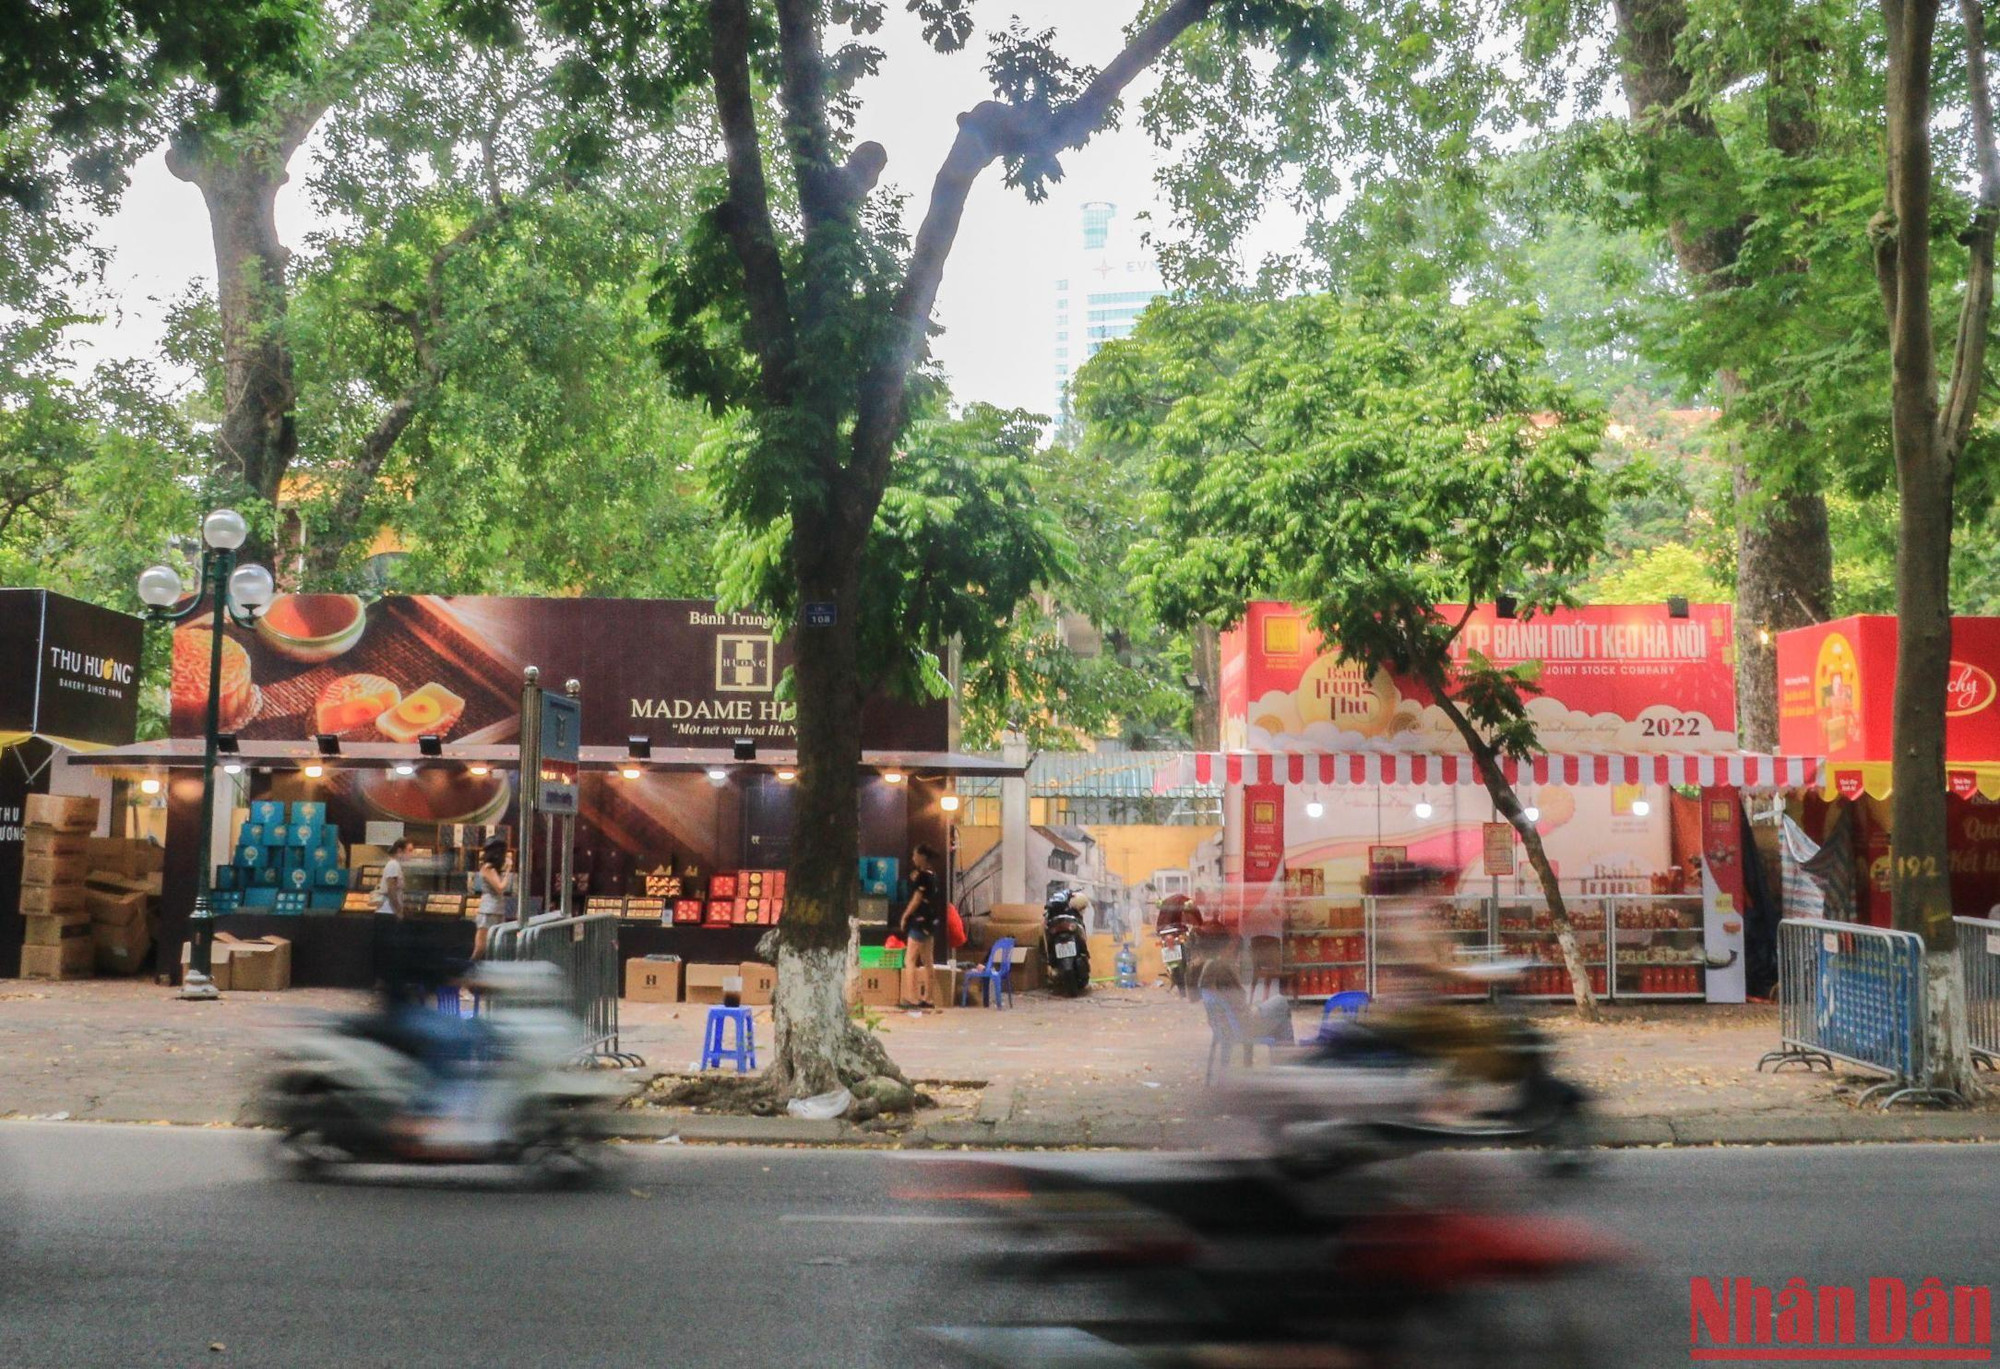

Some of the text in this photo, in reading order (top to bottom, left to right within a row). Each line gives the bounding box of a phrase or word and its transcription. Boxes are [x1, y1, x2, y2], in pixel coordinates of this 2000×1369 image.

[690, 611, 726, 625] Bánh
[1493, 619, 1548, 658] BÁNH
[1551, 620, 1598, 658] MỨT
[1645, 620, 1670, 658] HÀ
[1673, 620, 1707, 663] NỘI
[51, 647, 81, 673] THU
[1546, 666, 1577, 676] JOINT
[1581, 666, 1616, 676] STOCK
[1620, 666, 1676, 676] COMPANY
[87, 684, 106, 696] SINCE
[1947, 667, 1977, 708] chy
[631, 699, 752, 720] MADAME
[1641, 718, 1700, 736] 2022
[1898, 855, 1940, 878] 192
